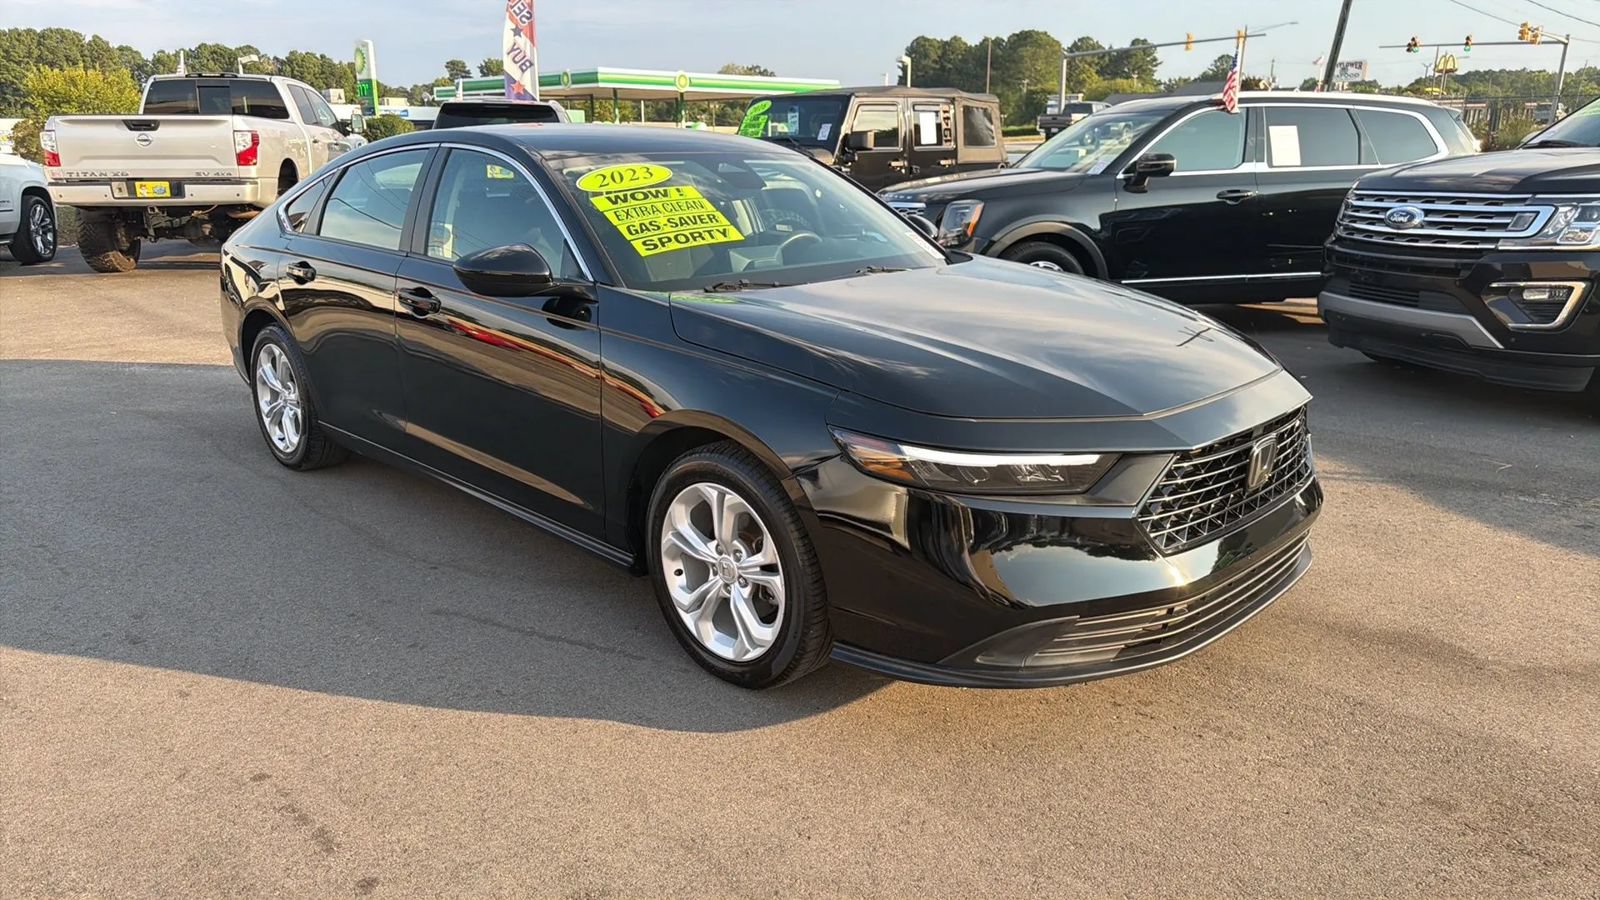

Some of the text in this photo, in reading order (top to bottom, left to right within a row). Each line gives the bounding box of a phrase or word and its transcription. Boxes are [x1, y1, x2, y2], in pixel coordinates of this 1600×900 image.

[595, 166, 654, 188] 2023
[605, 189, 669, 205] WOW
[614, 200, 705, 222] EXTRA CLEAN
[641, 228, 728, 251] SPORTY
